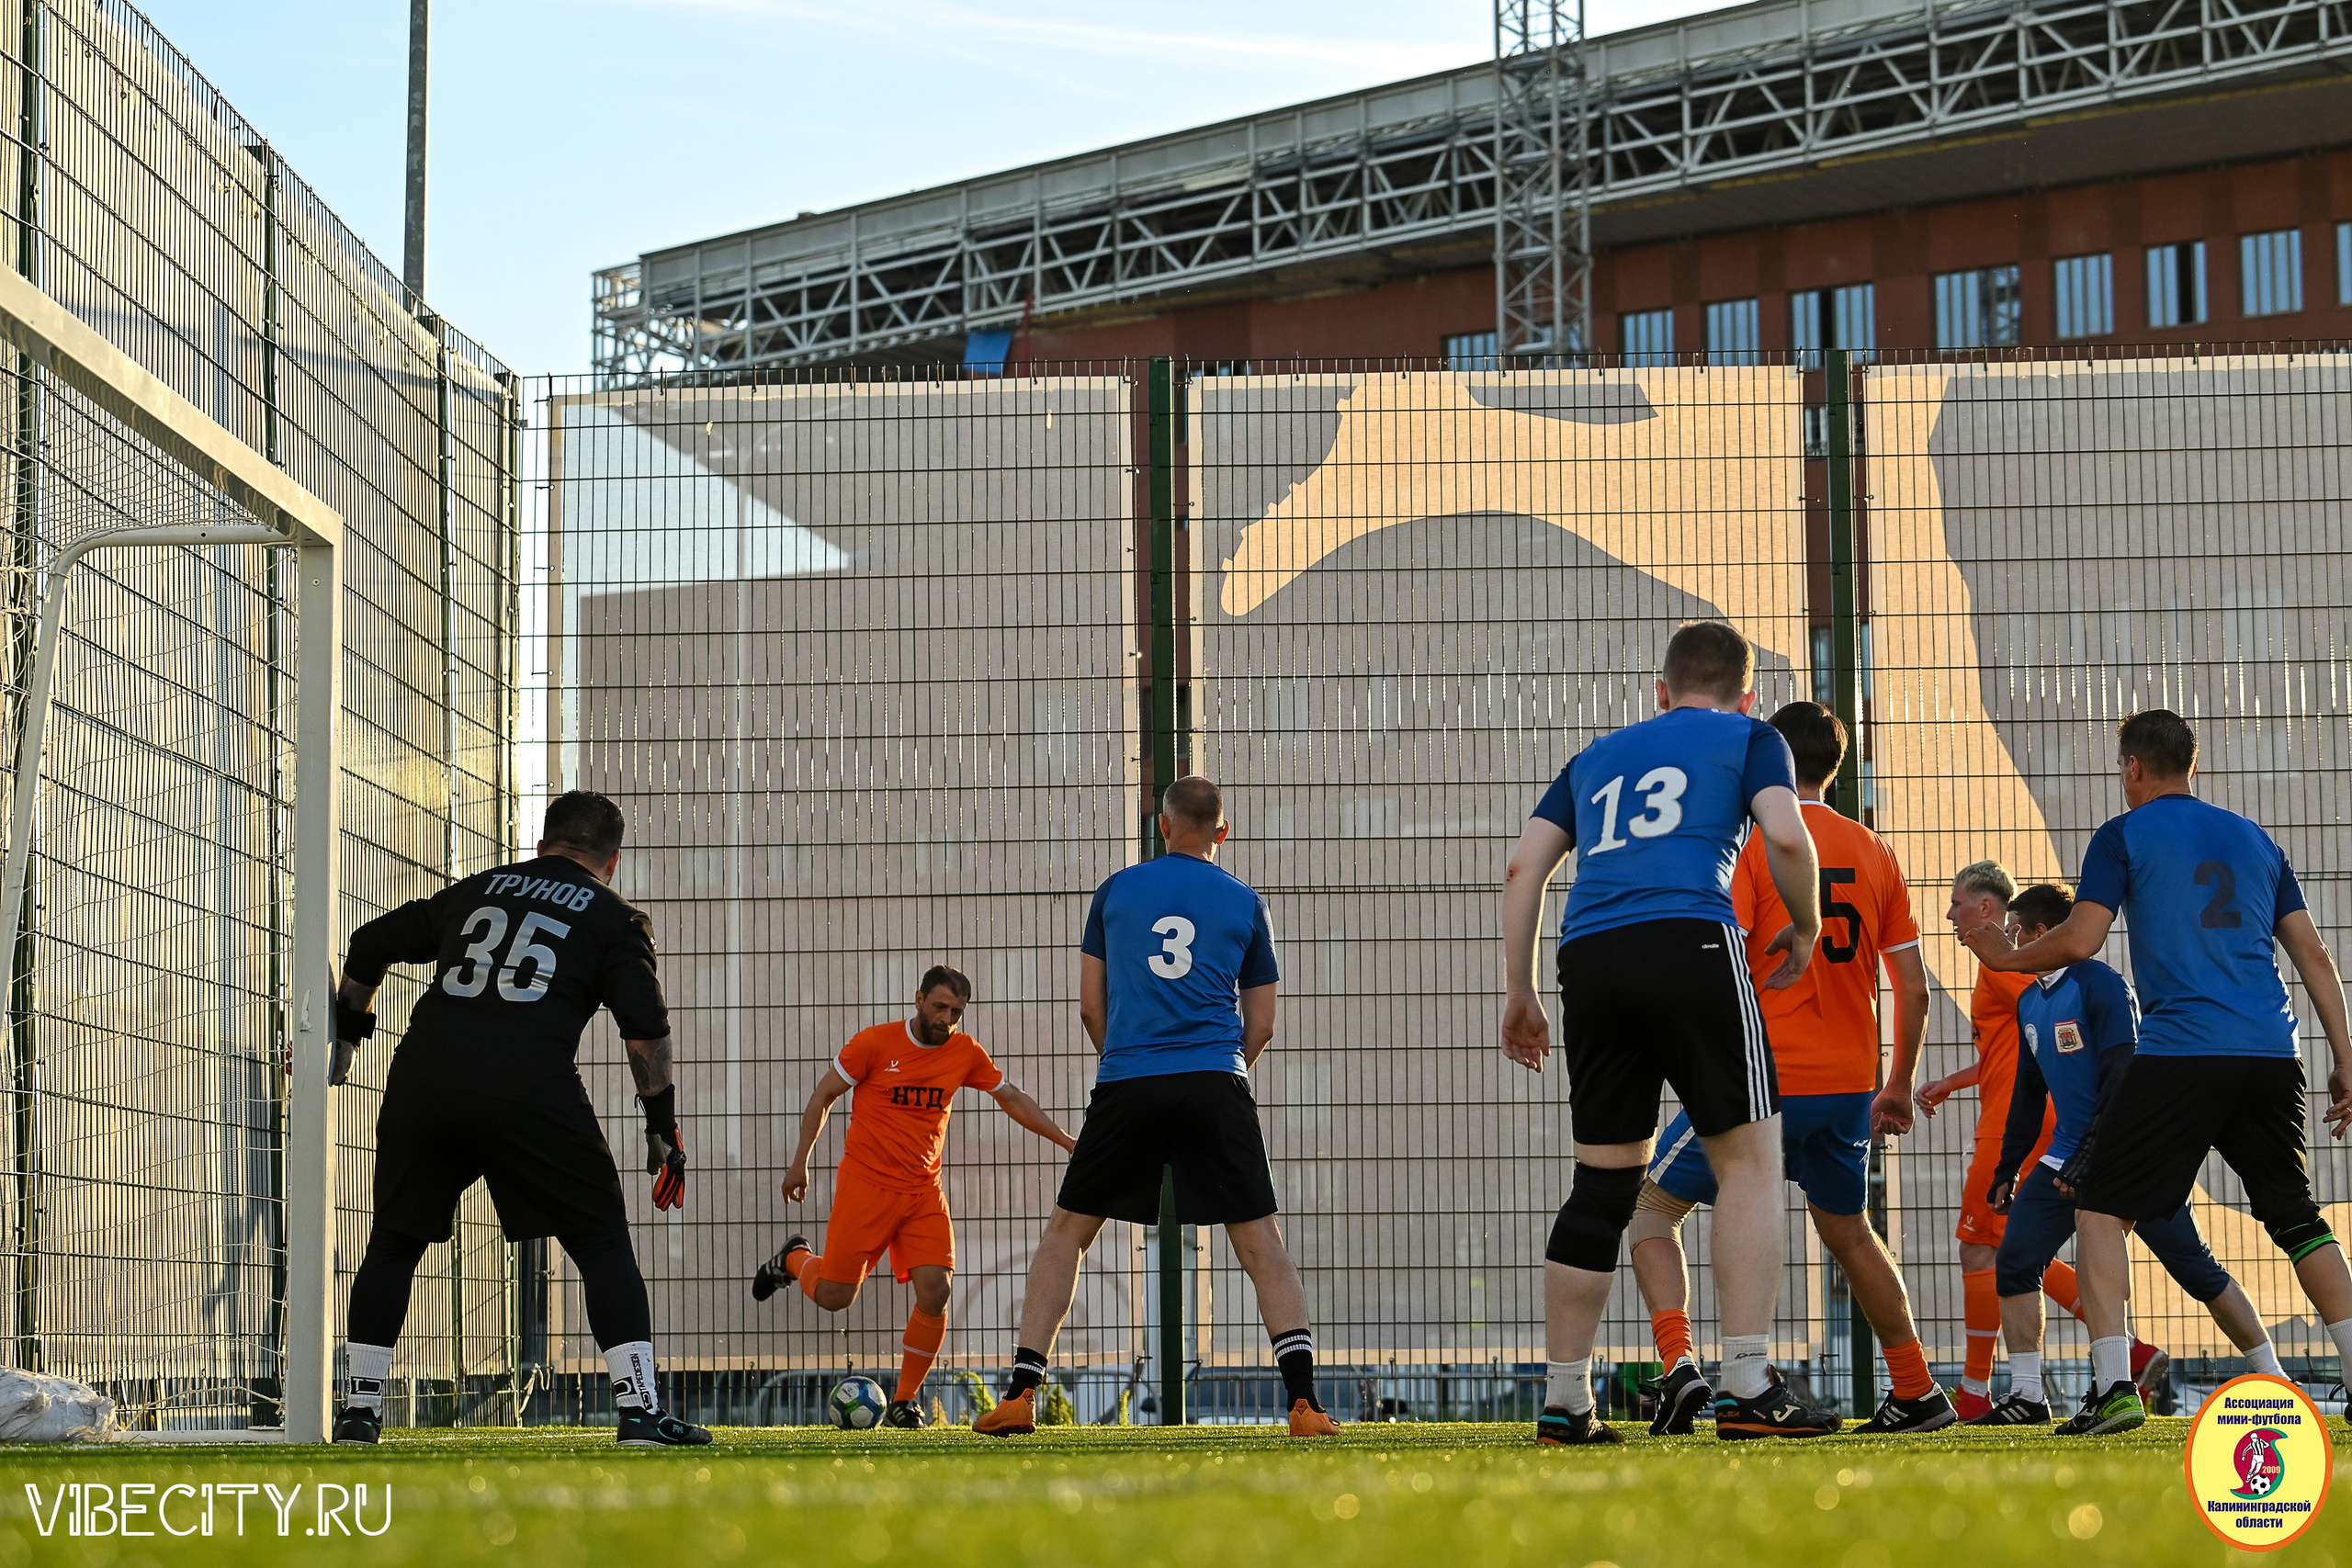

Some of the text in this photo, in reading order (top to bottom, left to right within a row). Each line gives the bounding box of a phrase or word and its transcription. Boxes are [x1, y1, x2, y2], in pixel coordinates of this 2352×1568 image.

[1588, 766, 1688, 856] 13
[484, 874, 595, 912] ТРУНОВ
[2193, 861, 2242, 929] 2
[442, 906, 571, 1002] 35
[1148, 916, 1195, 979] 3
[890, 1086, 944, 1111] НТД
[629, 1352, 646, 1393] TAPEDESIGN
